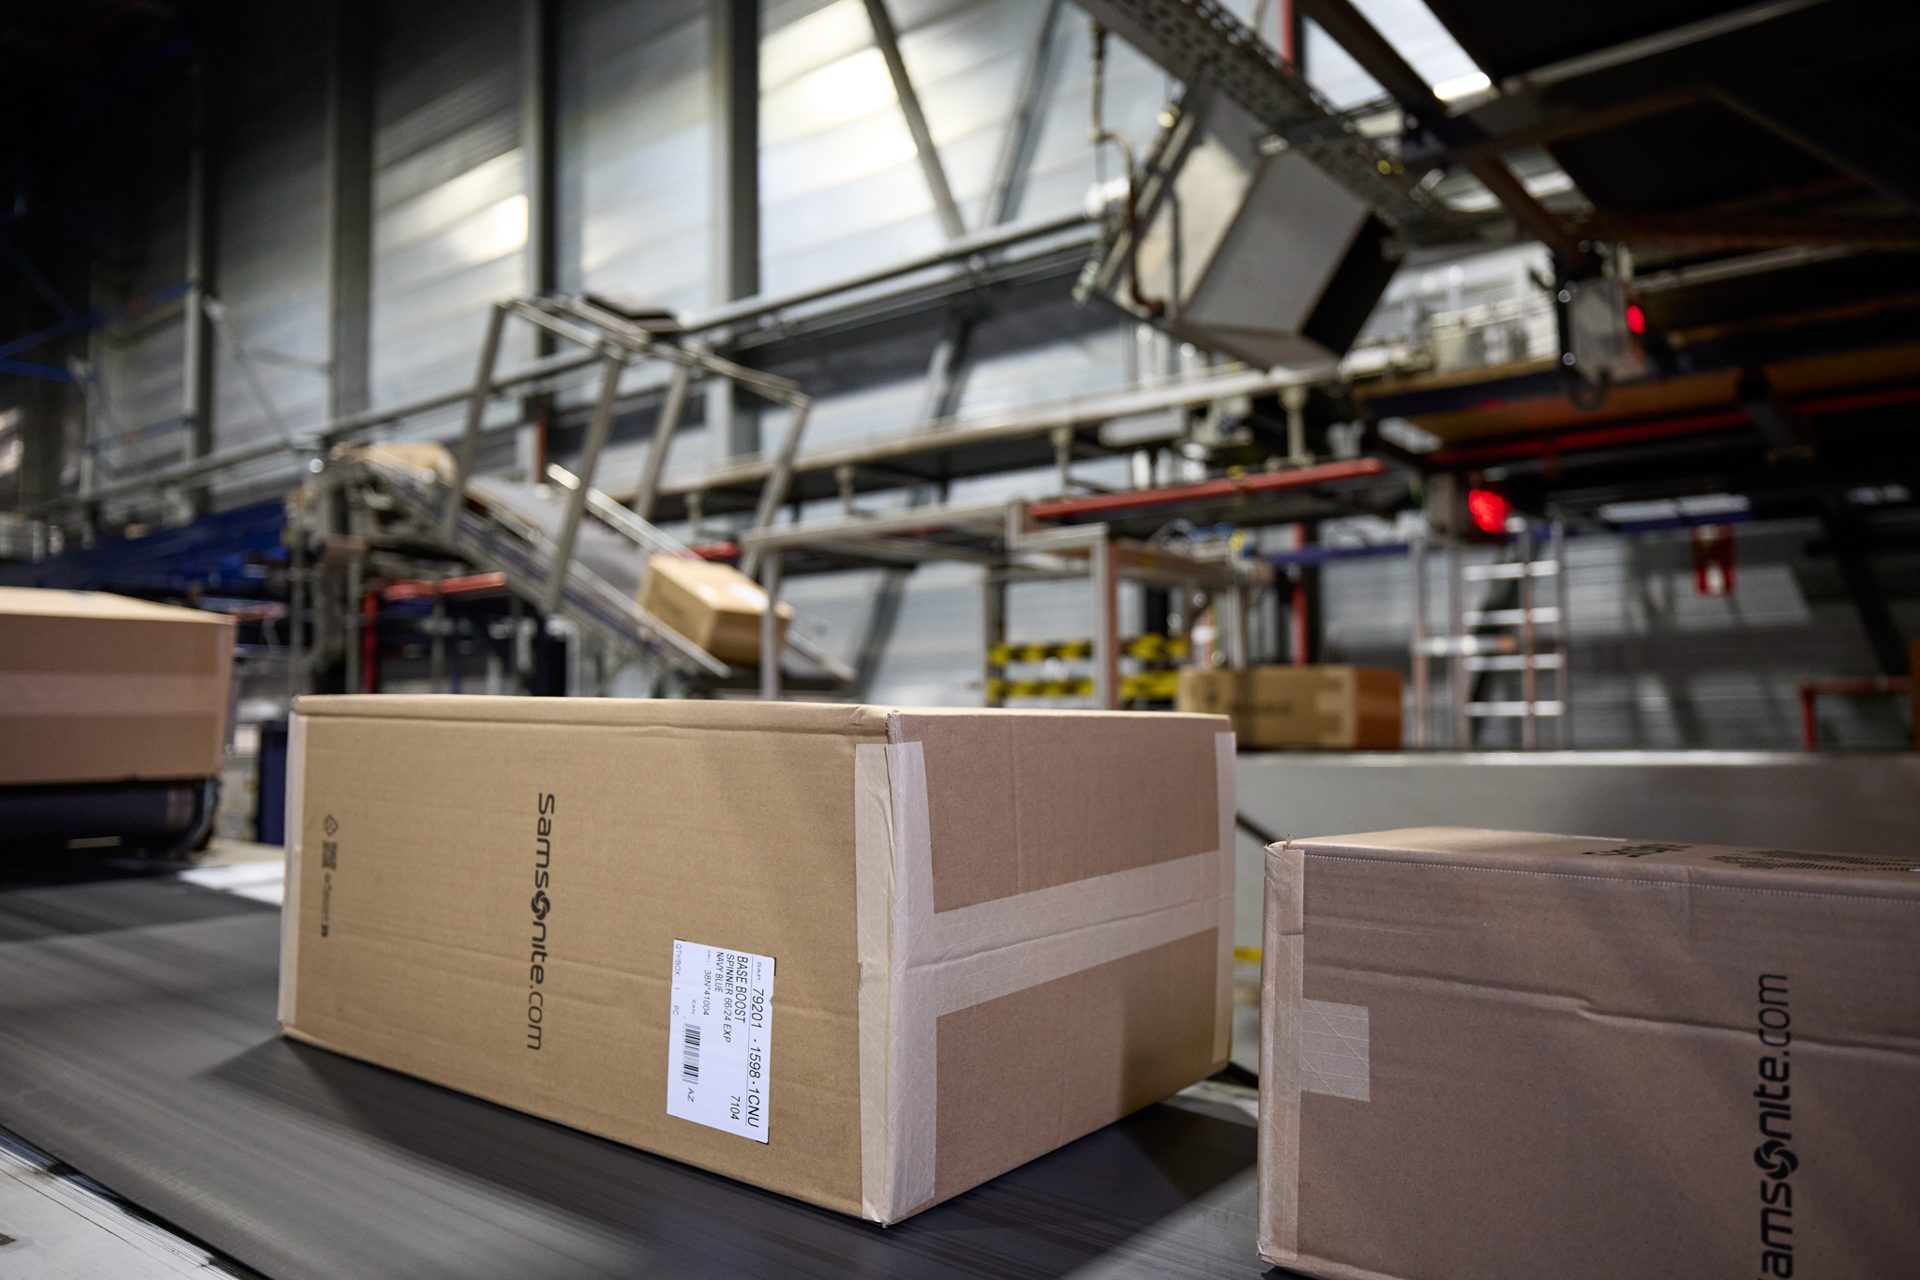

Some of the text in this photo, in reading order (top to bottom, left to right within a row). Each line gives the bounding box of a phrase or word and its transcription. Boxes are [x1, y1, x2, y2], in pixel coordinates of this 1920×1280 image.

[527, 792, 555, 1051] Samsonite.com
[714, 951, 725, 993] NAVY BLUE
[734, 955, 749, 1024] BASE BOOST
[672, 1005, 680, 1016] PC
[722, 953, 735, 1043] SPINNER 66/24 EXP
[751, 988, 764, 1029] 79201
[687, 1087, 695, 1103] AZ
[730, 1095, 741, 1121] 7104
[1753, 974, 1798, 1280] amsonite.com
